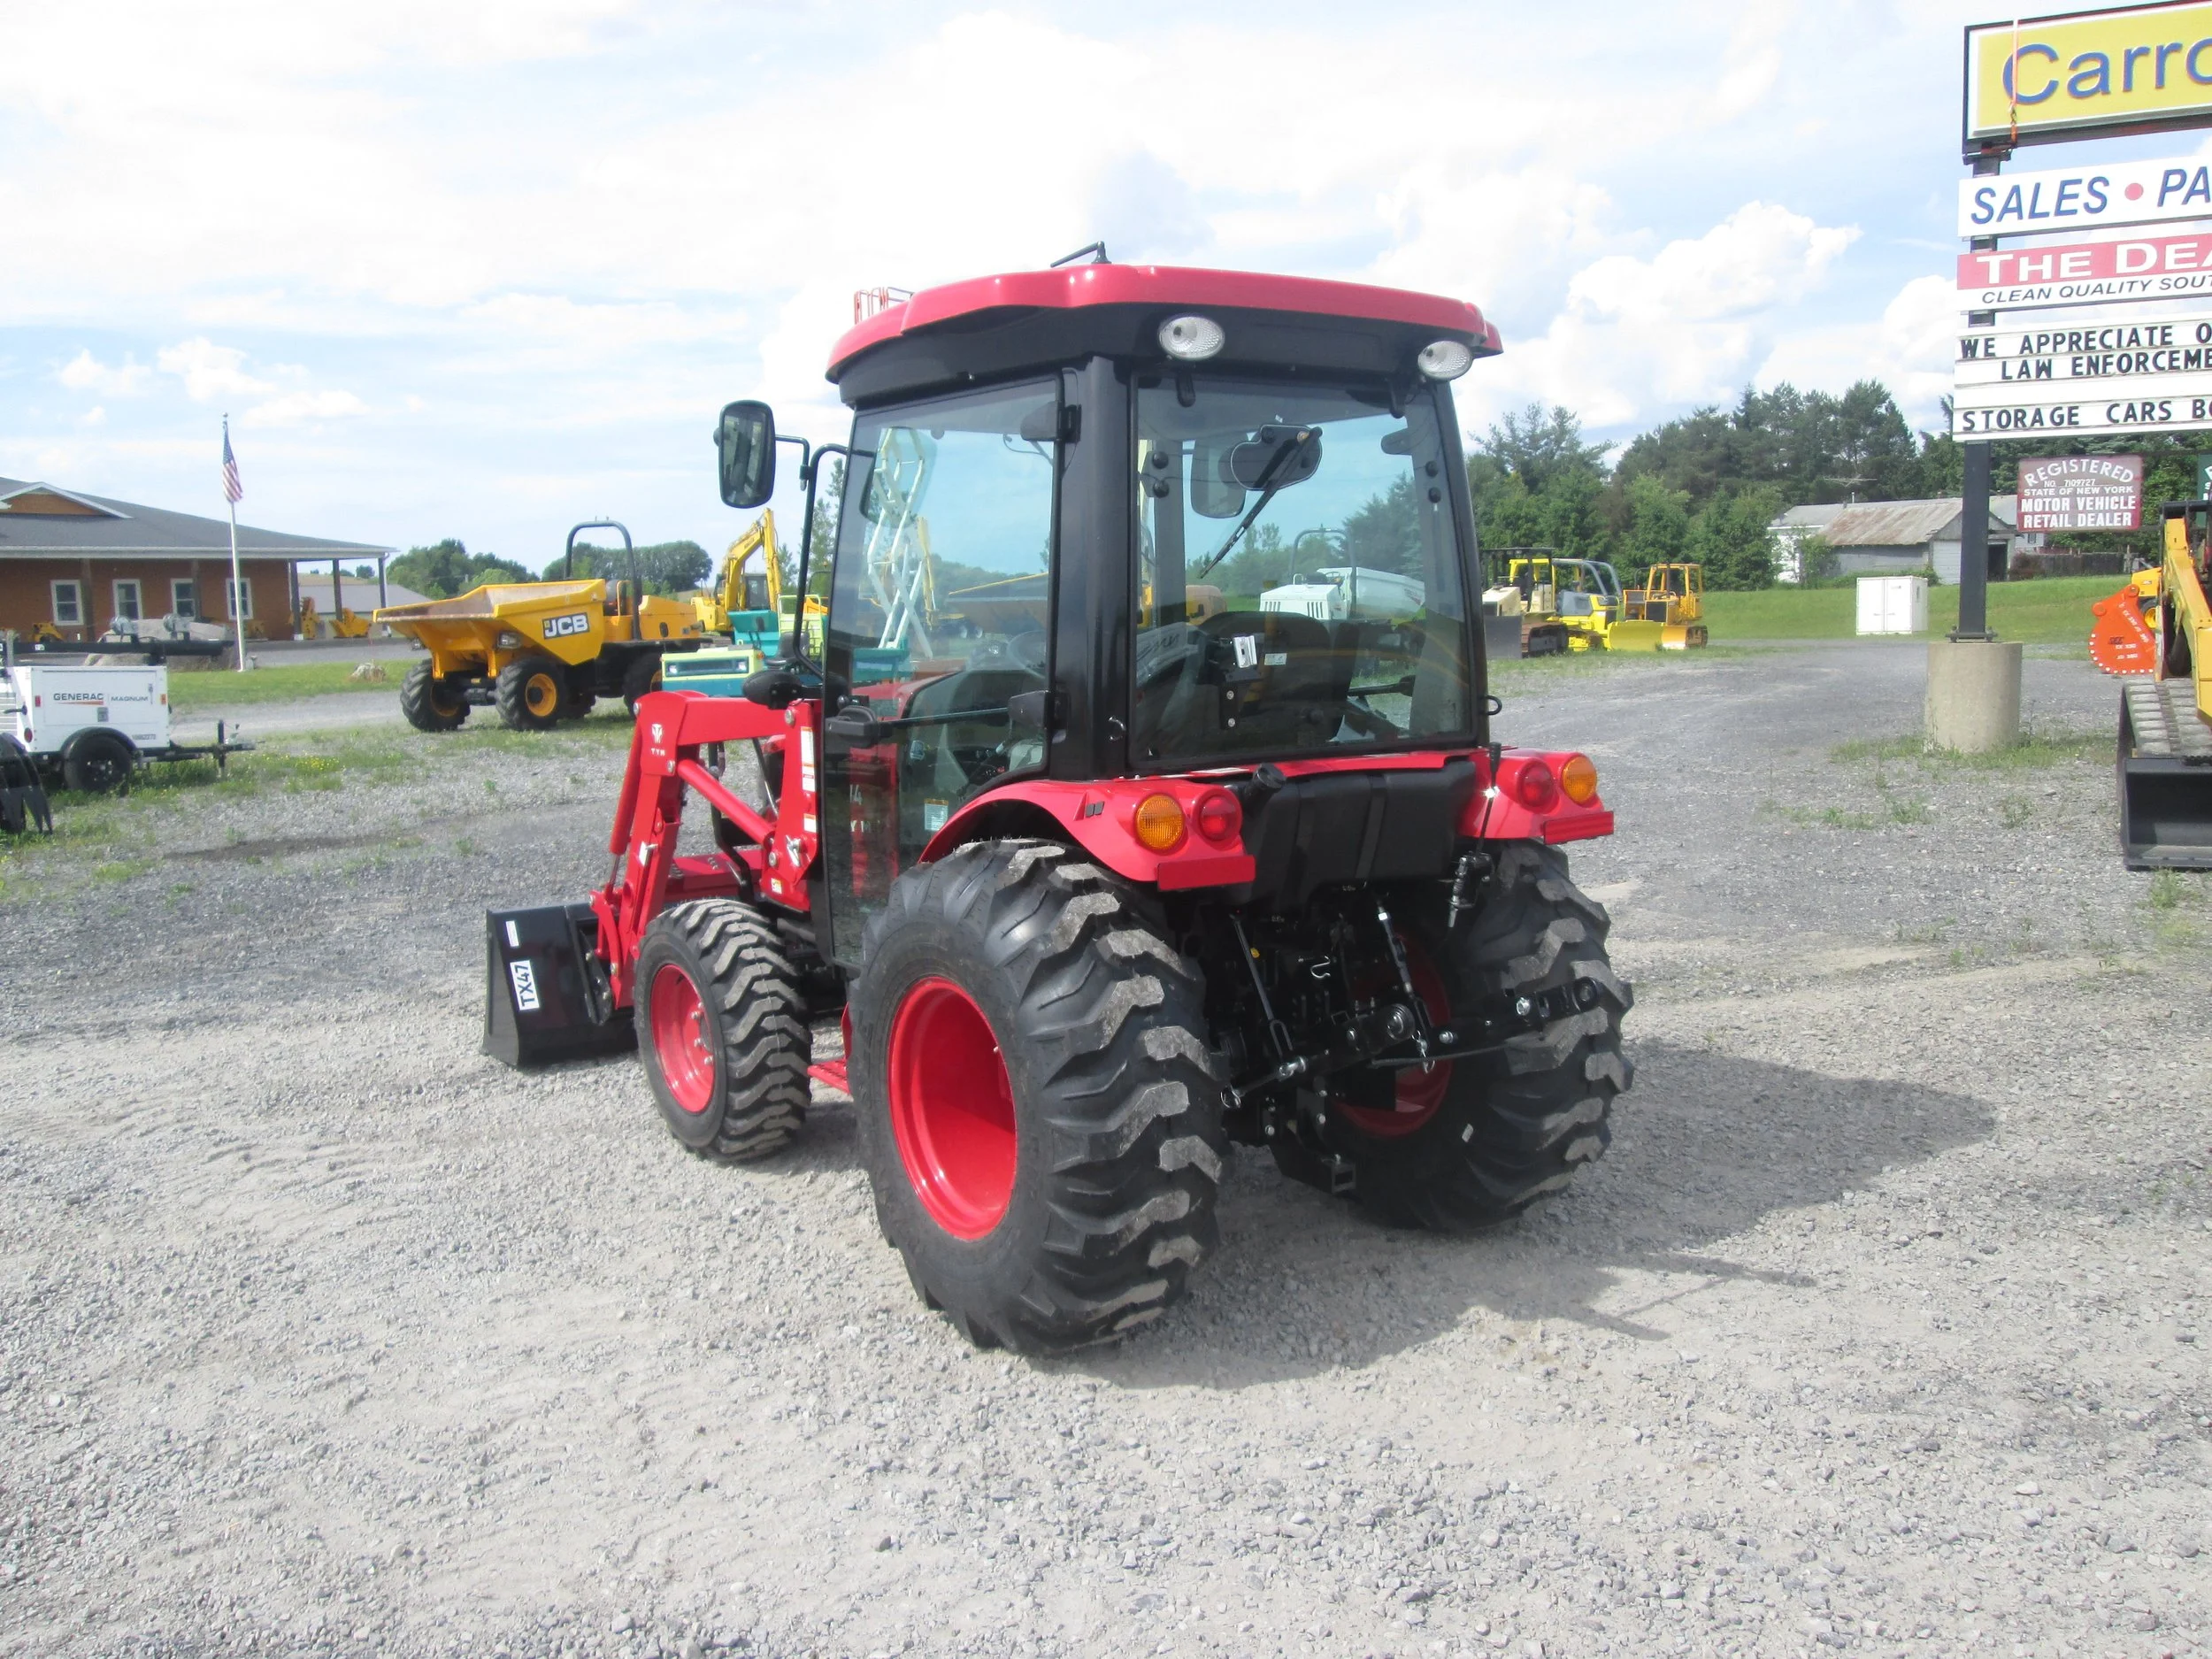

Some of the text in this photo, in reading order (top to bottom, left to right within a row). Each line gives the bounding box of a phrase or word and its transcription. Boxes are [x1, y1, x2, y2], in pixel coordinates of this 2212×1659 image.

[1970, 165, 2211, 225] SALES PA
[1977, 242, 2212, 284] THE DE
[1982, 288, 2052, 303] CLEAN
[2059, 279, 2153, 298] QUALITY
[1961, 337, 1996, 358] WE
[2020, 326, 2173, 355] APPRECIATE
[2001, 358, 2052, 380] LAW
[1962, 398, 2212, 431] STORAGE CARS B
[2024, 458, 2134, 487] REGISTERED
[2021, 495, 2136, 512] MOTOR VEHICLE
[2024, 488, 2055, 496] STATE
[2024, 511, 2132, 528] RETAIL DEALER
[543, 614, 588, 638] JCB
[650, 748, 666, 757] TYM
[514, 964, 535, 1007] TX47
